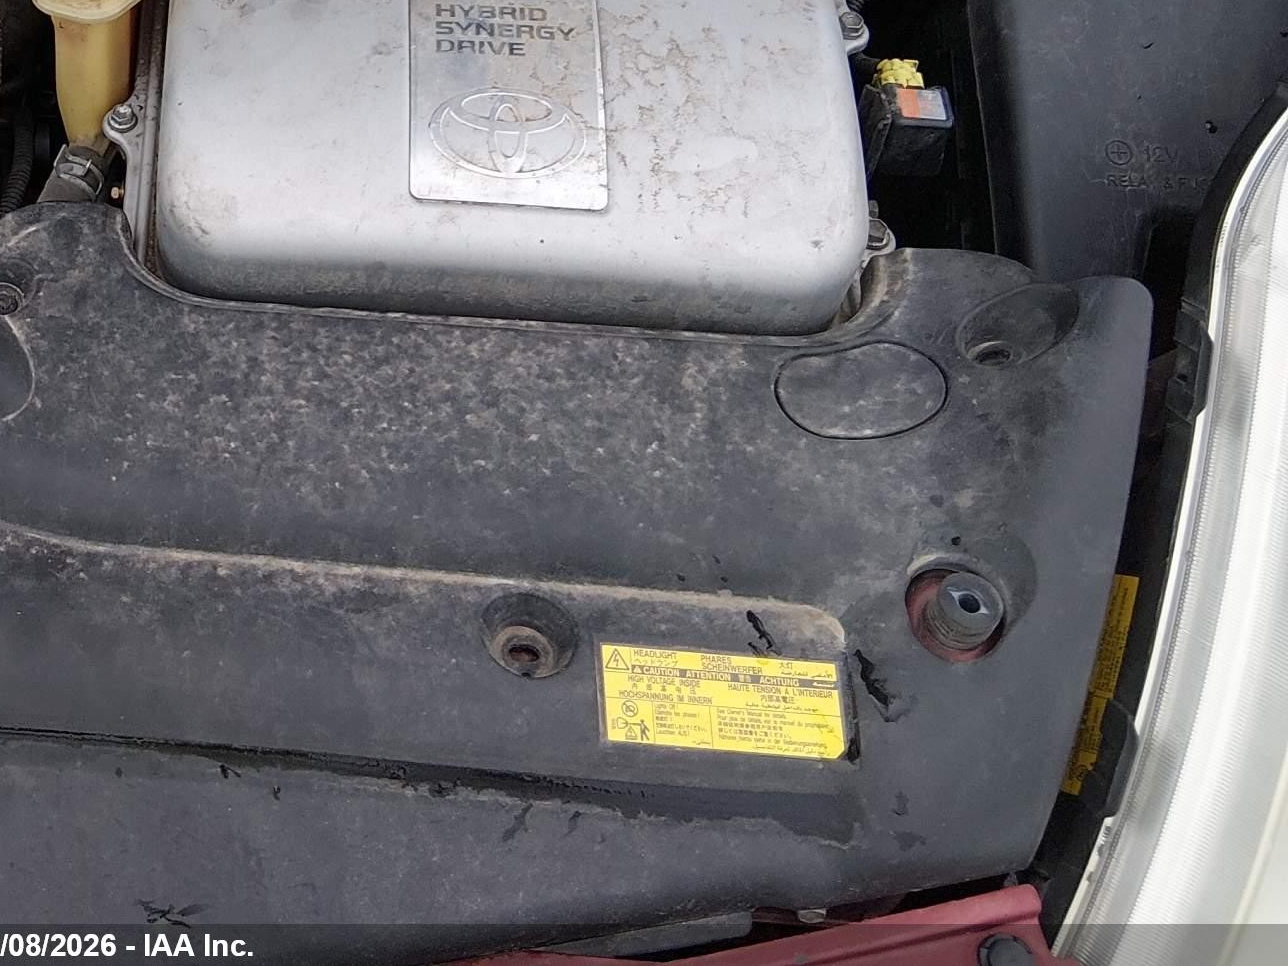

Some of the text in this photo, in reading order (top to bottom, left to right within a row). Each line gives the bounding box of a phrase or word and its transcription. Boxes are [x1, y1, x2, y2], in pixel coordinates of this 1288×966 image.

[435, 3, 548, 22] HYBRID
[435, 21, 577, 41] SYNERGY
[435, 39, 526, 57] DRIVE
[634, 649, 732, 665] HEADLIGHT PHARES
[643, 666, 680, 677] CAUTION
[685, 671, 731, 682] ATTENTION
[759, 676, 800, 687] ACHTUNG
[701, 662, 763, 675] SCHEINWERFER
[628, 675, 701, 688] HIGH VOLTAGE INSIDE
[728, 683, 751, 693] HAUTE
[753, 685, 781, 695] TENSION
[619, 689, 674, 702] HOCHSPANNUNG
